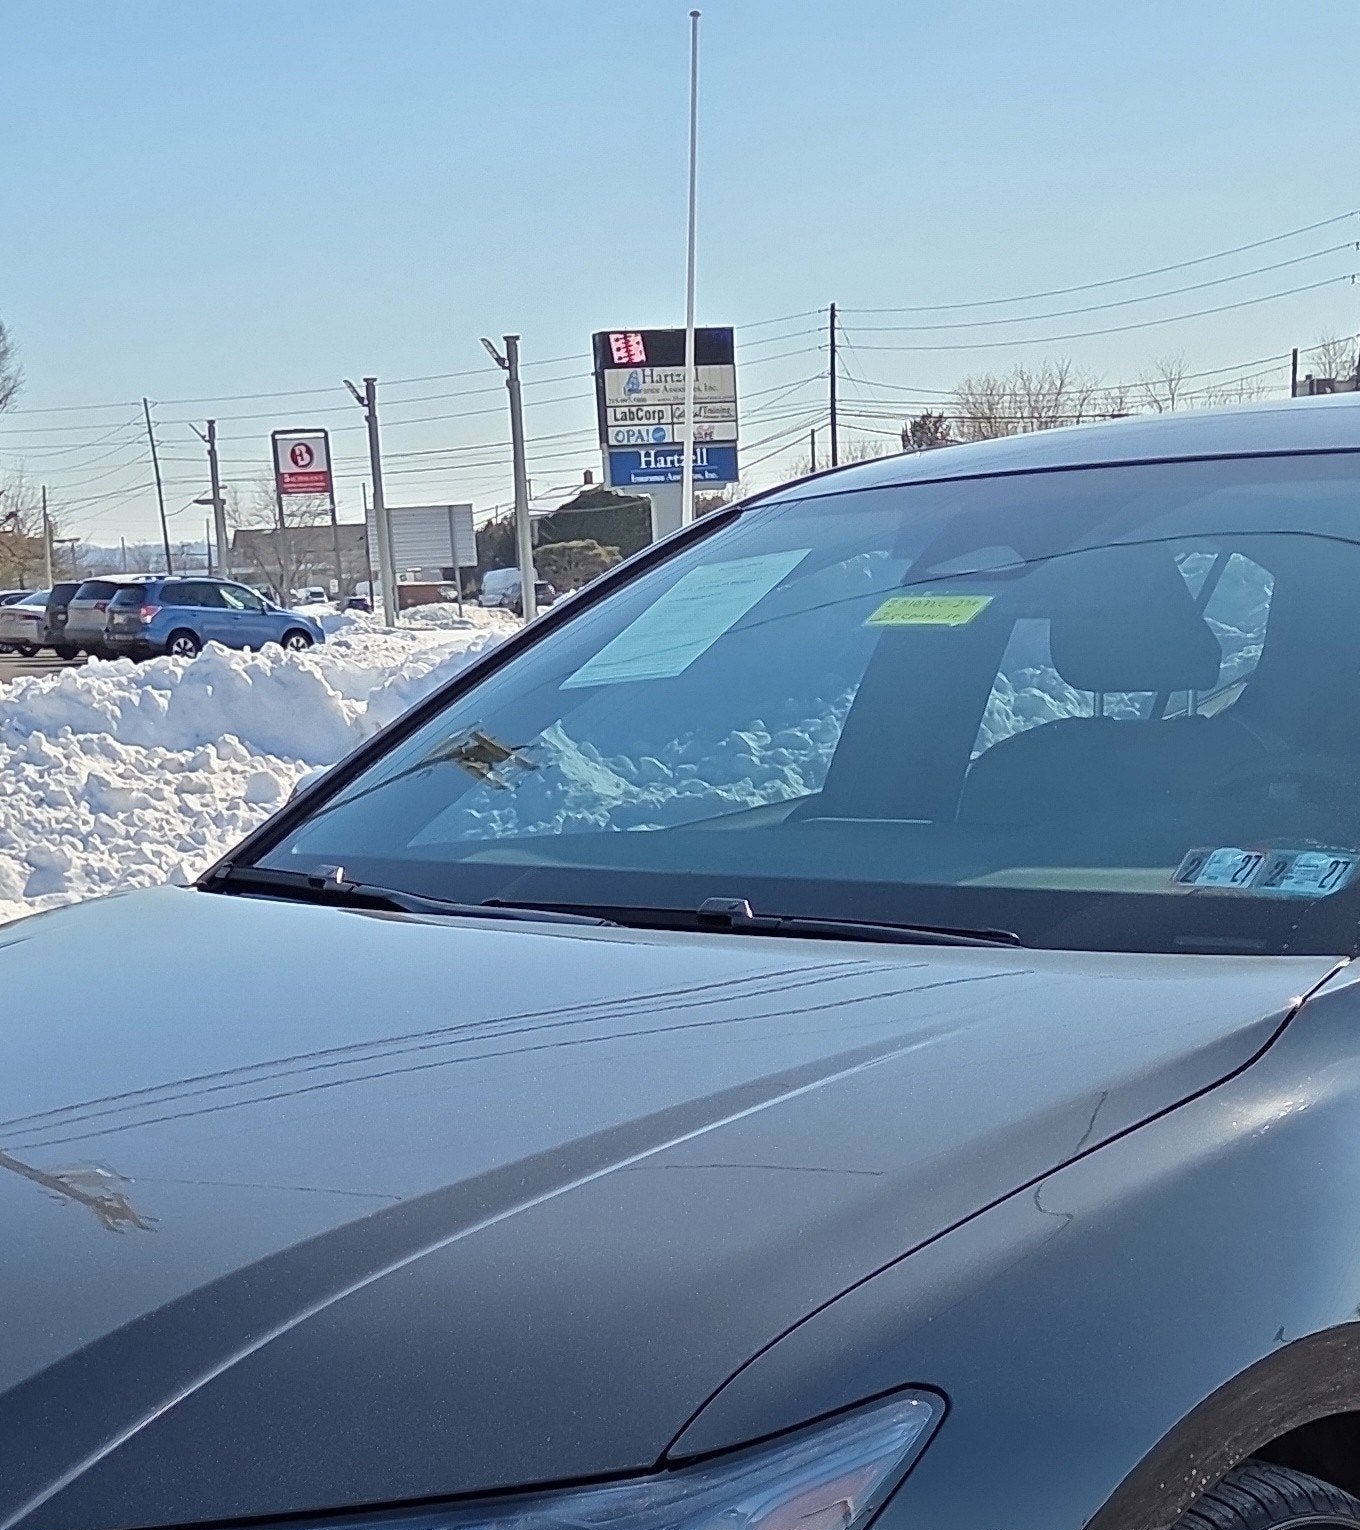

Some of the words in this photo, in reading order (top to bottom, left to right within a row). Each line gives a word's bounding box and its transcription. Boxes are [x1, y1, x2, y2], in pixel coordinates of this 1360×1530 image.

[641, 367, 699, 384] Hartzl
[613, 408, 665, 423] LabCorp
[614, 429, 650, 443] OPA!
[1230, 854, 1263, 886] 27
[1317, 859, 1352, 891] 27
